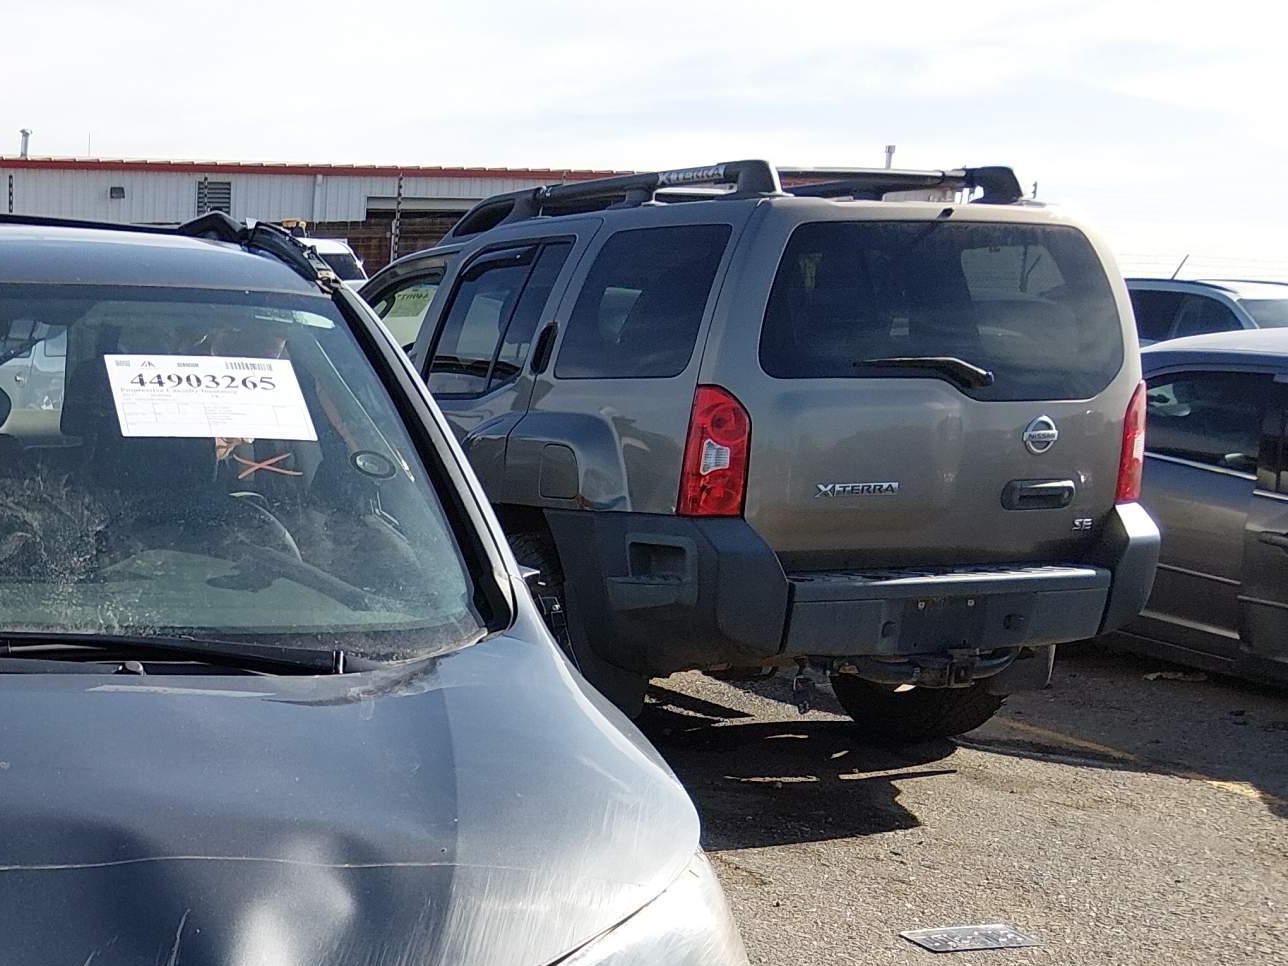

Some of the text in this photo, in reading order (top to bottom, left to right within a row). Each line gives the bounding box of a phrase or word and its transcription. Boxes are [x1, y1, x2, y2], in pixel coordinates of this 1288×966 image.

[130, 373, 277, 391] 44903265
[1028, 431, 1055, 440] NISSAN
[815, 482, 899, 498] XTERRA
[1072, 518, 1093, 530] SE
